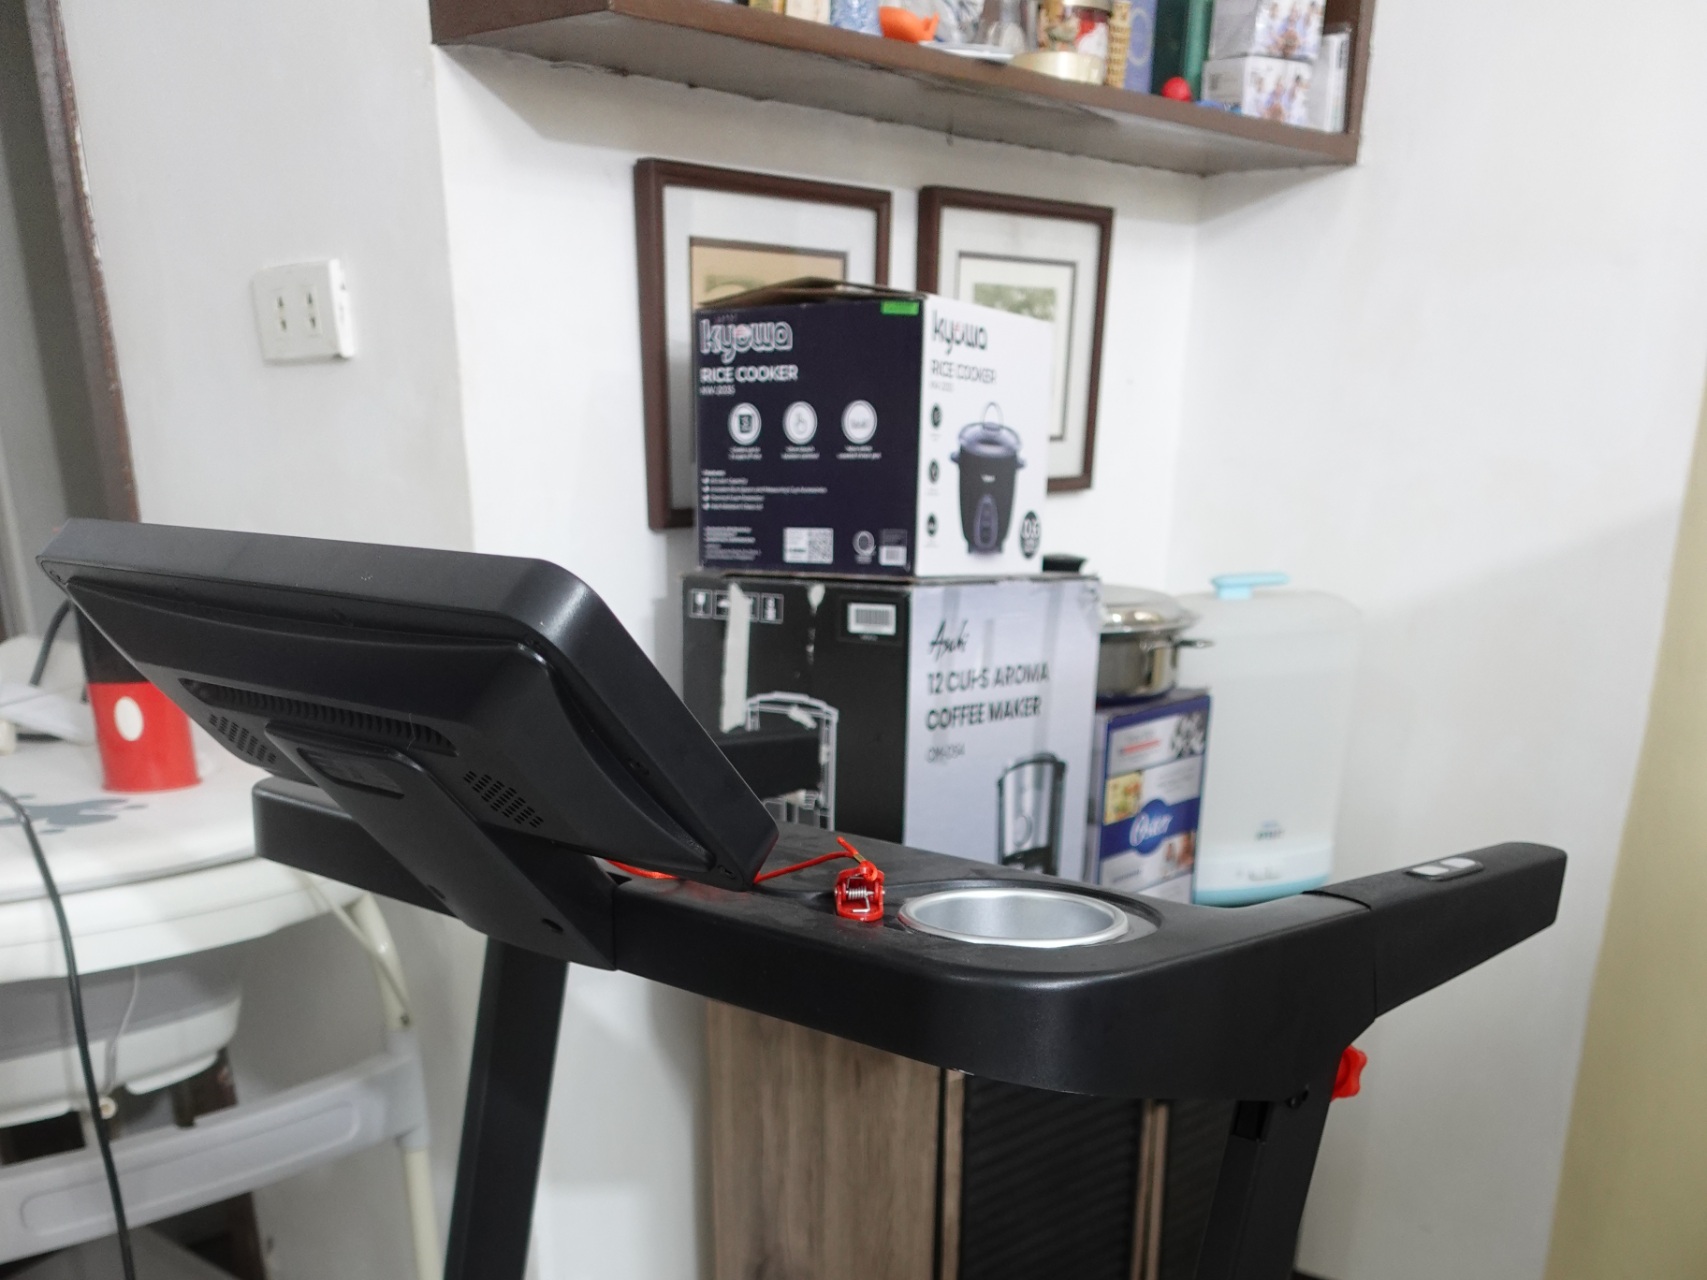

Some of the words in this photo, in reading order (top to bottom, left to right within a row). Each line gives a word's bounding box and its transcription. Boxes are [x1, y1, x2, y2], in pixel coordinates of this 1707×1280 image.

[700, 318, 793, 364] kyowa
[931, 310, 988, 355] kyowa
[700, 366, 734, 383] RICE
[735, 364, 799, 382] COOKER
[931, 359, 954, 378] RICE
[957, 363, 997, 384] COOKER
[928, 672, 943, 694] 12
[994, 662, 1049, 686] AROMA
[926, 703, 985, 730] COFFEE
[988, 696, 1042, 722] MAKER
